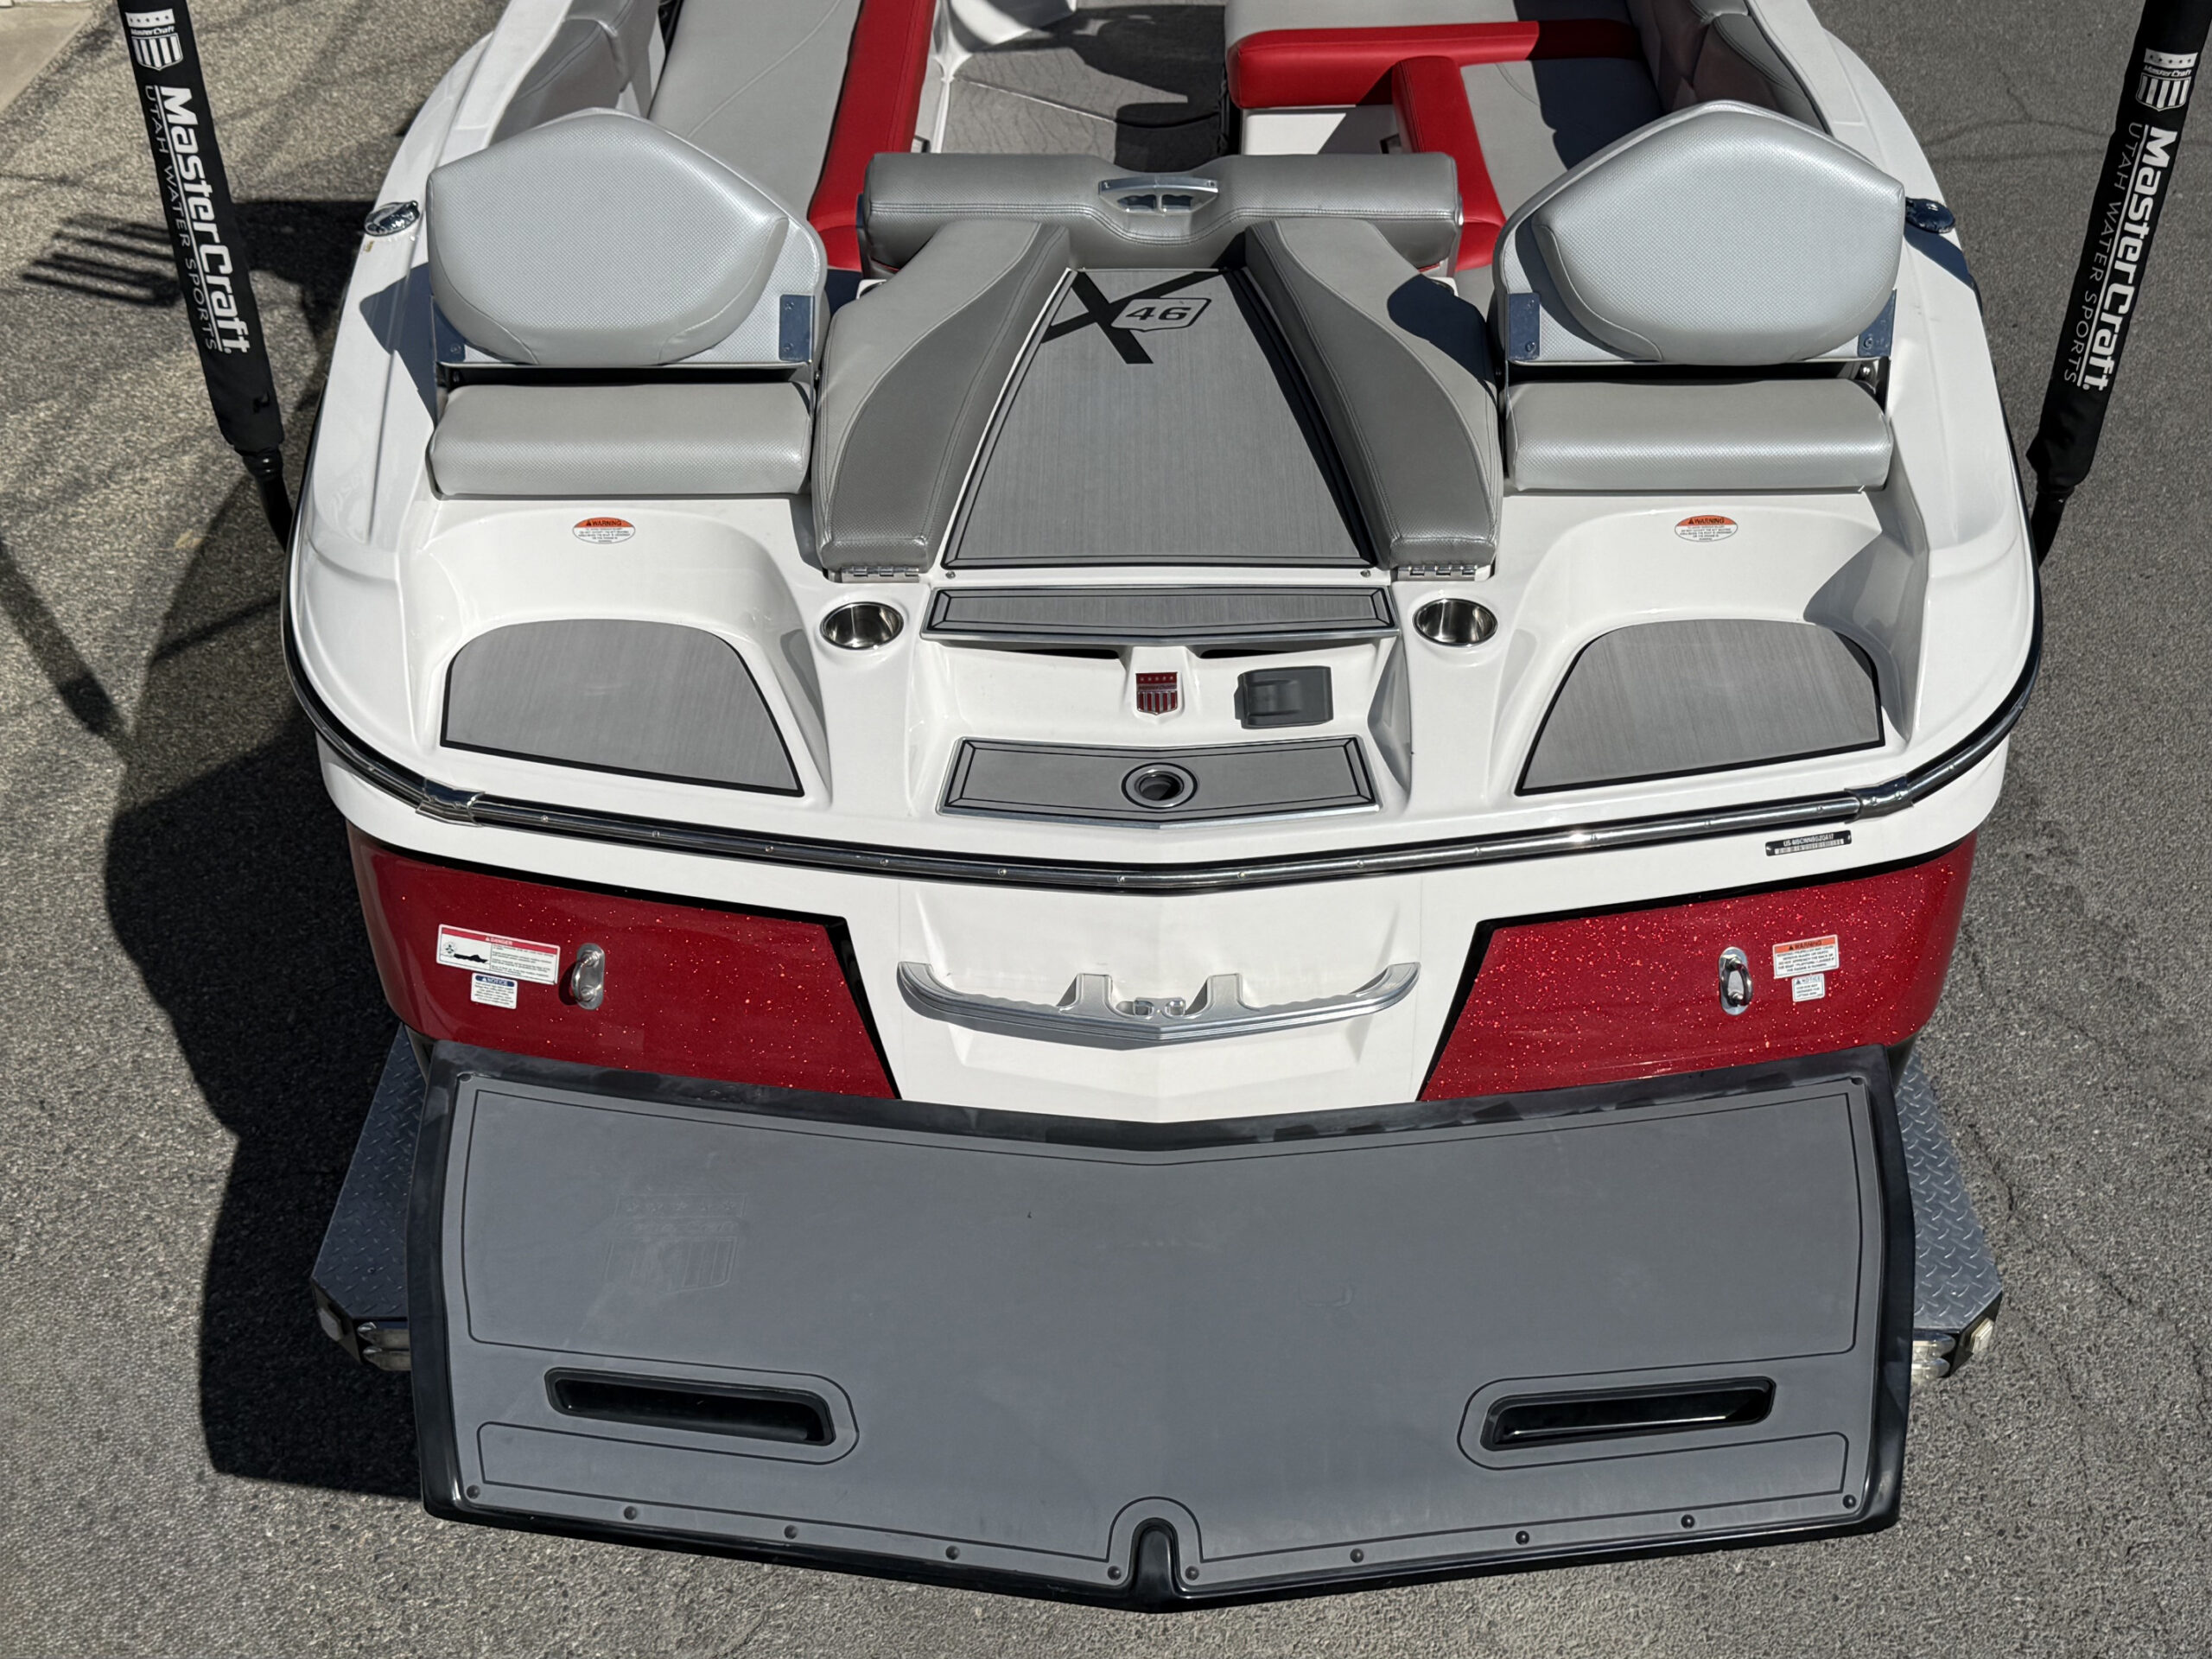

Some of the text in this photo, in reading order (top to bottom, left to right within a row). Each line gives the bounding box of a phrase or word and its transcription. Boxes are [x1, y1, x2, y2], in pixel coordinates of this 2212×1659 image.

[144, 85, 217, 350] UTAH WATER SPORTS
[2063, 121, 2143, 384] UTAH WATER SPORTS
